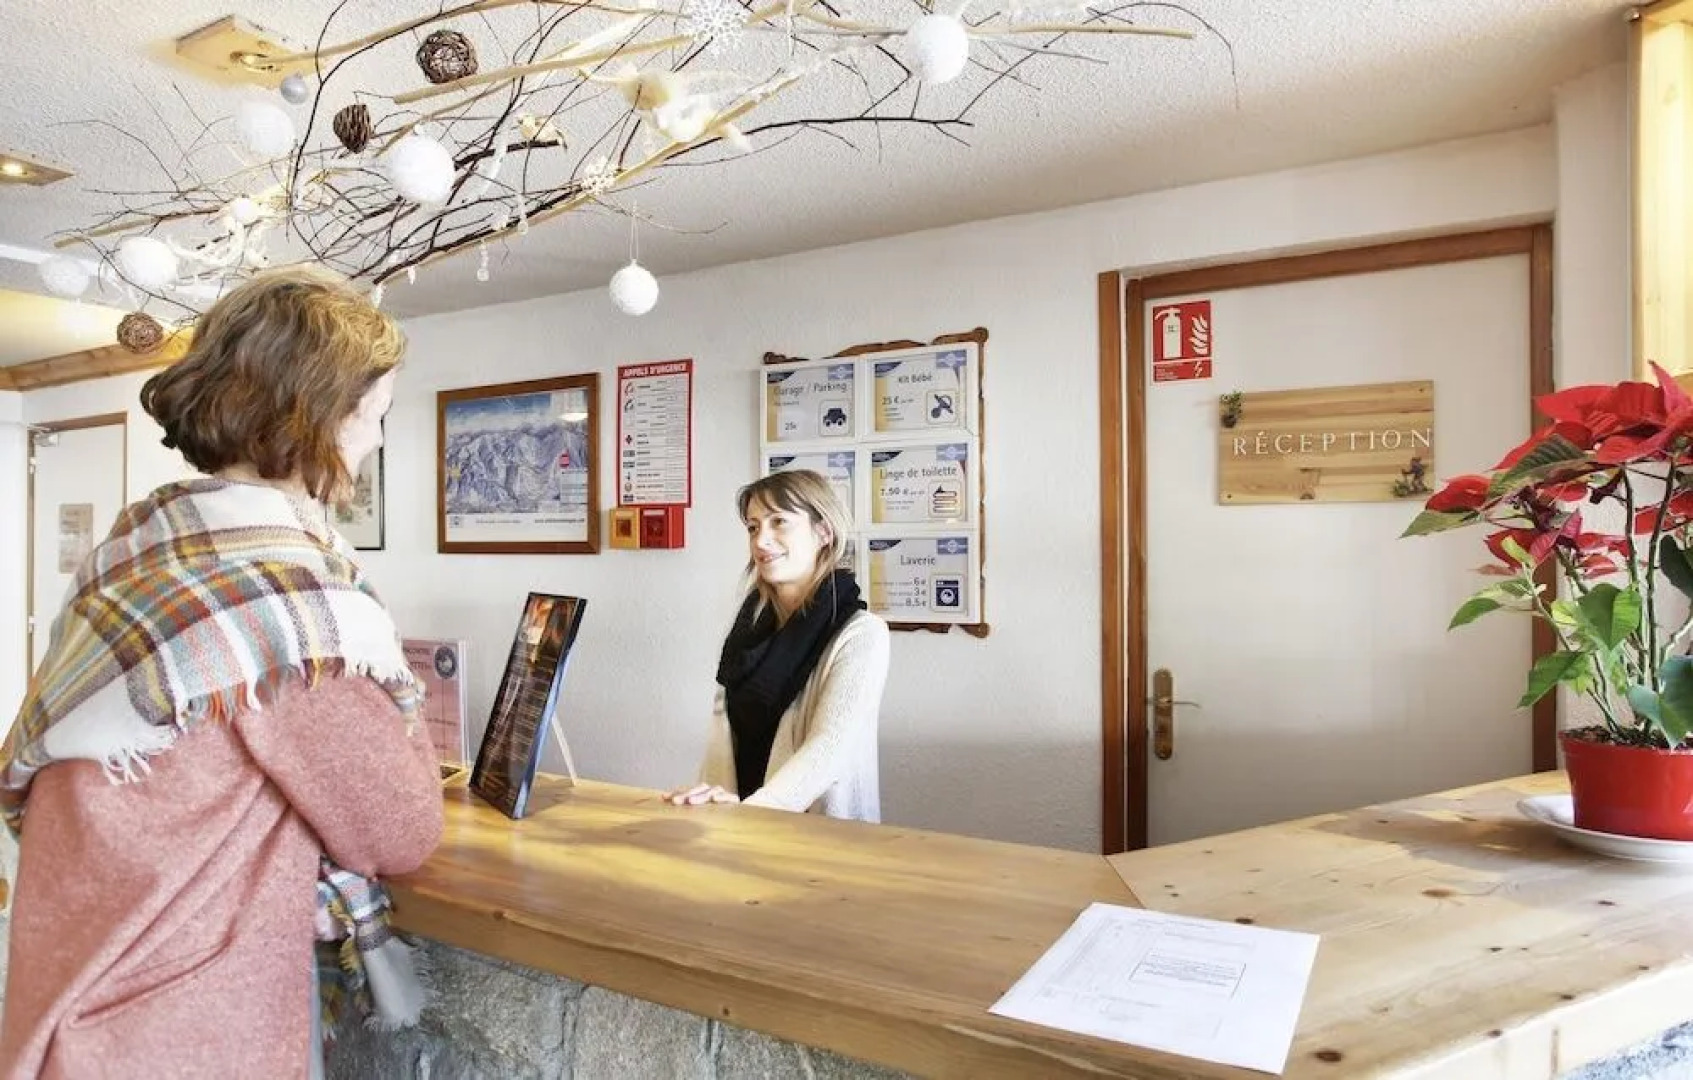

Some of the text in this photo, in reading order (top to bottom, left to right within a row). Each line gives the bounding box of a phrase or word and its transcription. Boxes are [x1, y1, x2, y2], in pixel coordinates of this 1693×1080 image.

[814, 381, 848, 394] Parking
[1232, 427, 1432, 458] RÉCEPTION
[879, 465, 957, 482] Linge de toilette
[900, 554, 936, 566] Laverie
